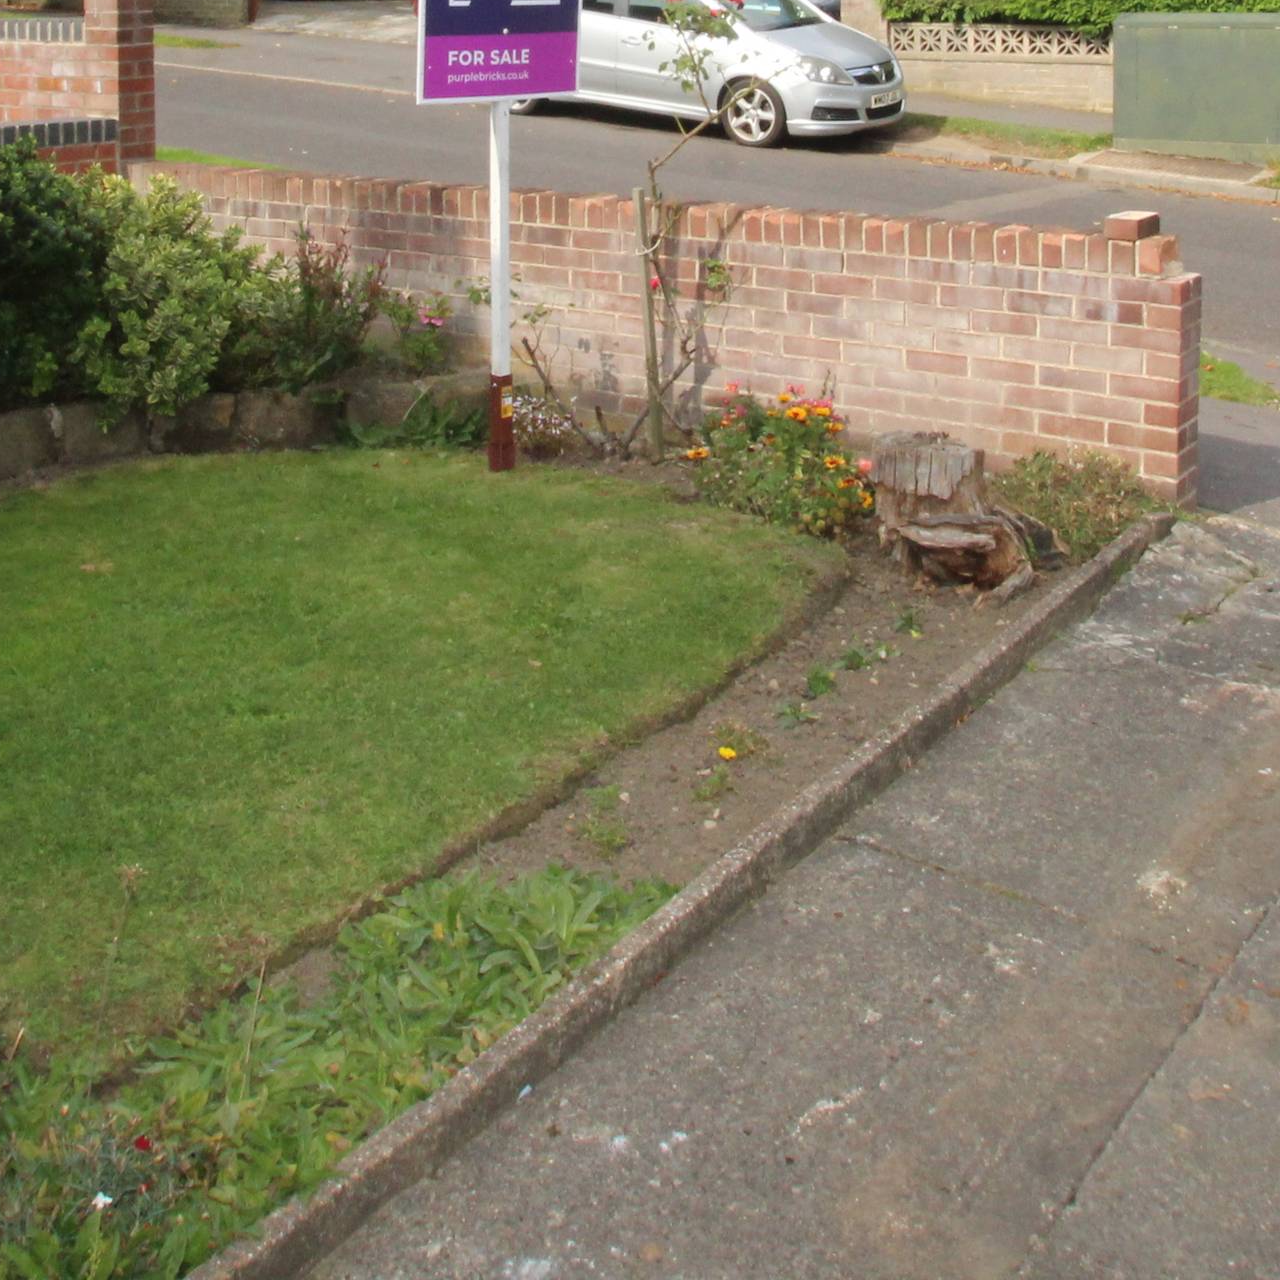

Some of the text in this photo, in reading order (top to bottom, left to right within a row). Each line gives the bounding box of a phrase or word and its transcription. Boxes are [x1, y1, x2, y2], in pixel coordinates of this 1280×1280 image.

[448, 48, 530, 66] FOR SALE
[448, 71, 529, 84] purplebricks.co.uk
